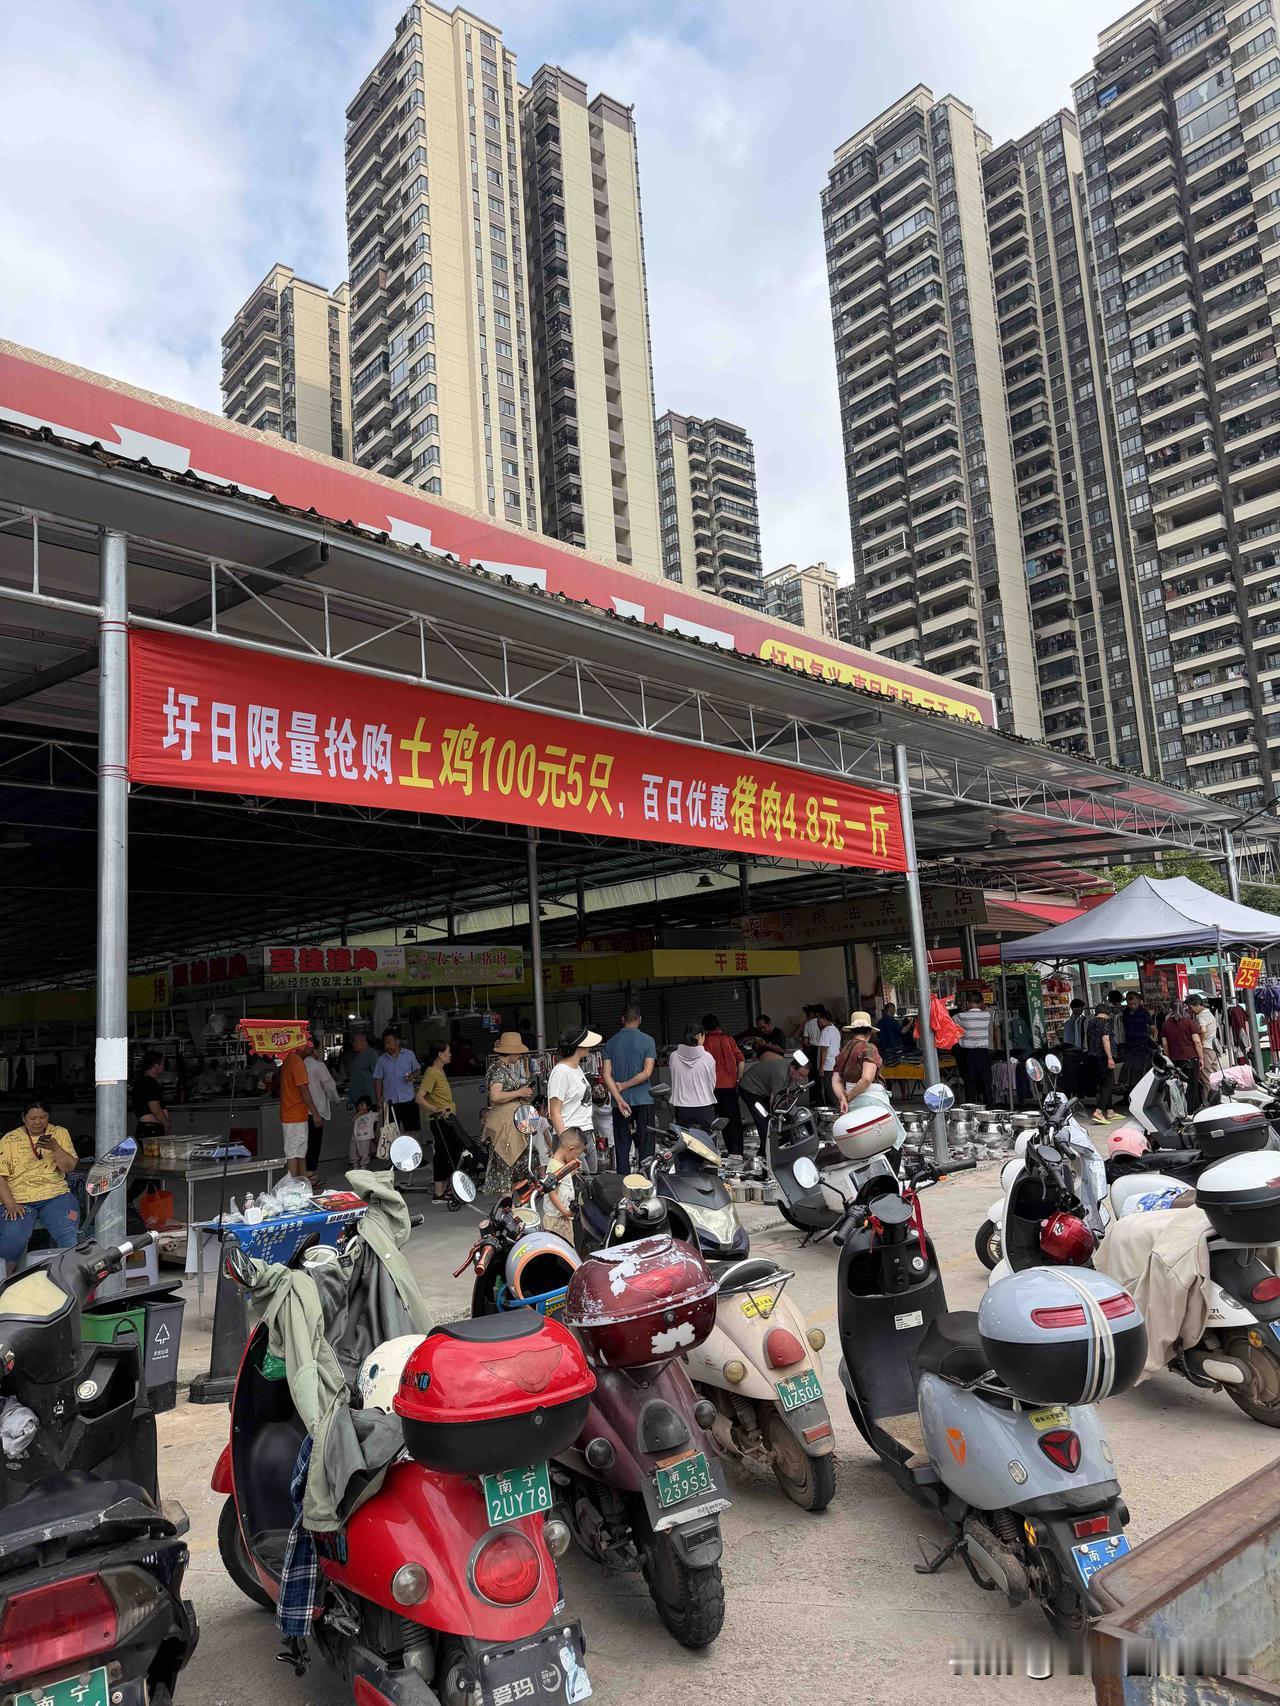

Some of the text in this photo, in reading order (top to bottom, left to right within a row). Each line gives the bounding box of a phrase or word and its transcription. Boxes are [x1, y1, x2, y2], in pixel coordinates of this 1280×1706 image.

[714, 952, 749, 972] 干蔬
[783, 1383, 821, 1408] UZ506
[497, 1472, 536, 1495] 南宁
[664, 1471, 707, 1503] 239S3
[492, 1486, 548, 1521] 2UY78
[1087, 1545, 1117, 1562] 南宁
[492, 1677, 535, 1706] 爱玛
